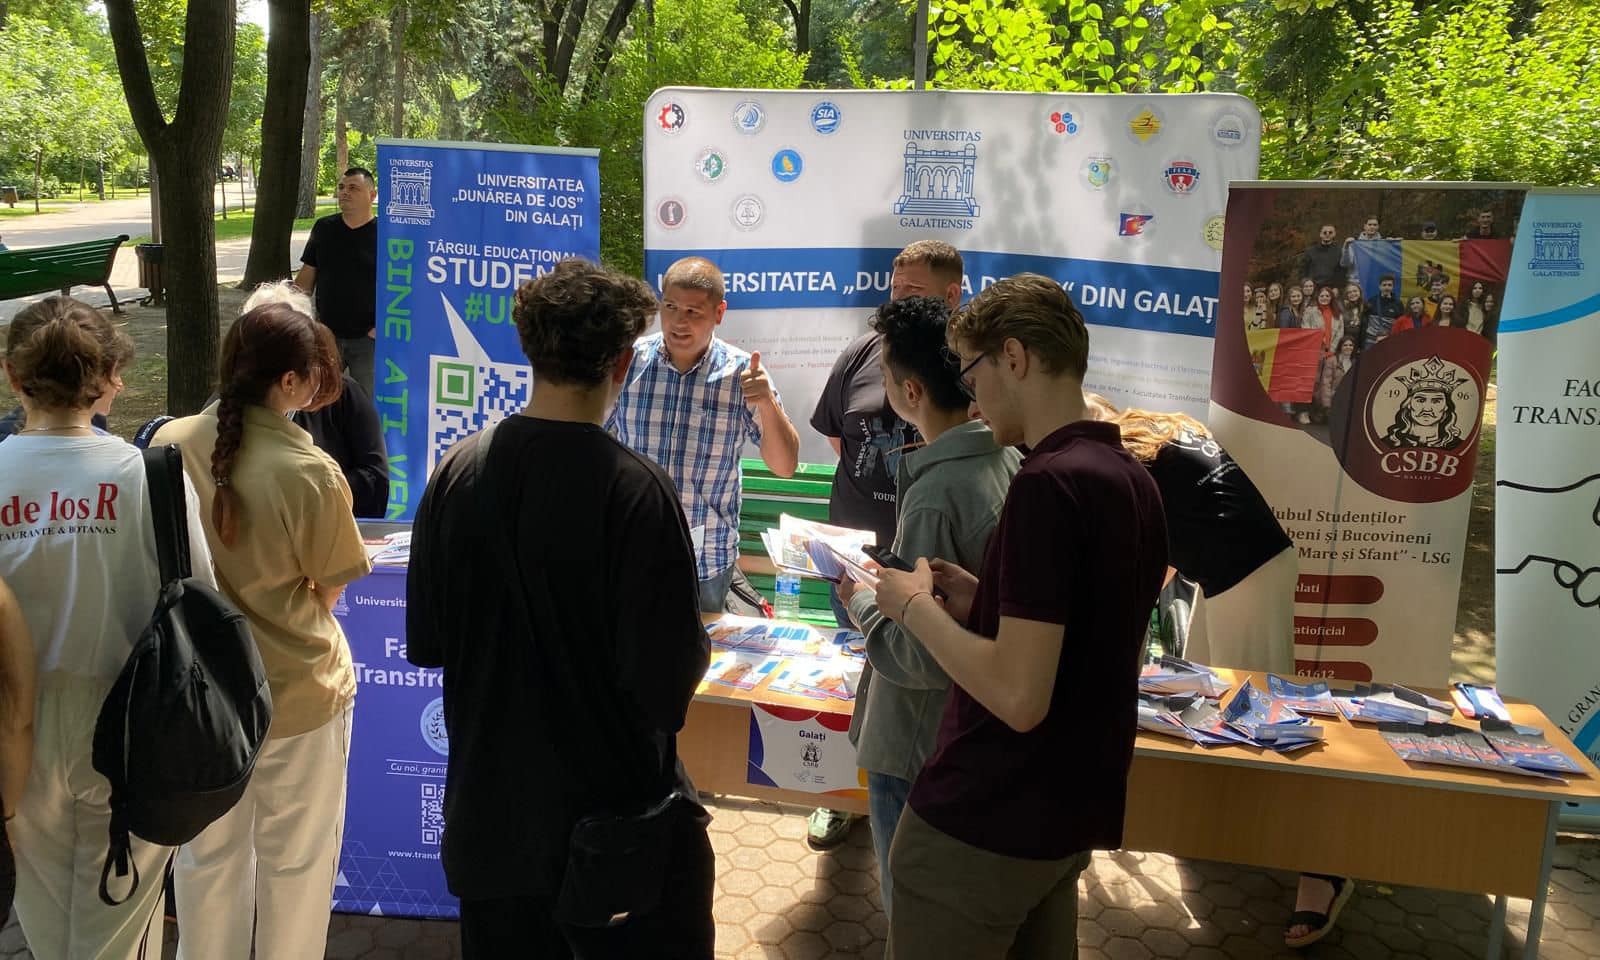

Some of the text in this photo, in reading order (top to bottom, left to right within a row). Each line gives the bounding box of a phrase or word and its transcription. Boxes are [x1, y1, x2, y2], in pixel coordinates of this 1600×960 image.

[903, 130, 982, 142] UNIVERSITAS
[390, 159, 434, 168] UNIVERSITAS
[477, 173, 585, 193] UNIVERSITATEA
[526, 193, 546, 207] DE
[505, 209, 583, 231] DIN GALAȚI
[900, 217, 974, 230] GALATIENSIS
[427, 239, 481, 257] TÂRGUL
[385, 239, 414, 343] BINE
[1081, 283, 1126, 310] DIN
[376, 358, 409, 437] AȚI
[1387, 389, 1470, 401] 19 96
[1512, 405, 1600, 426] TRANS
[1380, 450, 1460, 477] CSBB
[873, 491, 896, 502] YOUR
[0, 495, 41, 528] de
[50, 491, 90, 521] los
[1315, 509, 1407, 527] Studenților
[1324, 529, 1338, 544] și
[1342, 530, 1432, 545] Bucovineni
[1297, 546, 1339, 560] Mare
[1343, 549, 1354, 563] și
[1421, 551, 1452, 565] LSG
[390, 762, 402, 772] Cu
